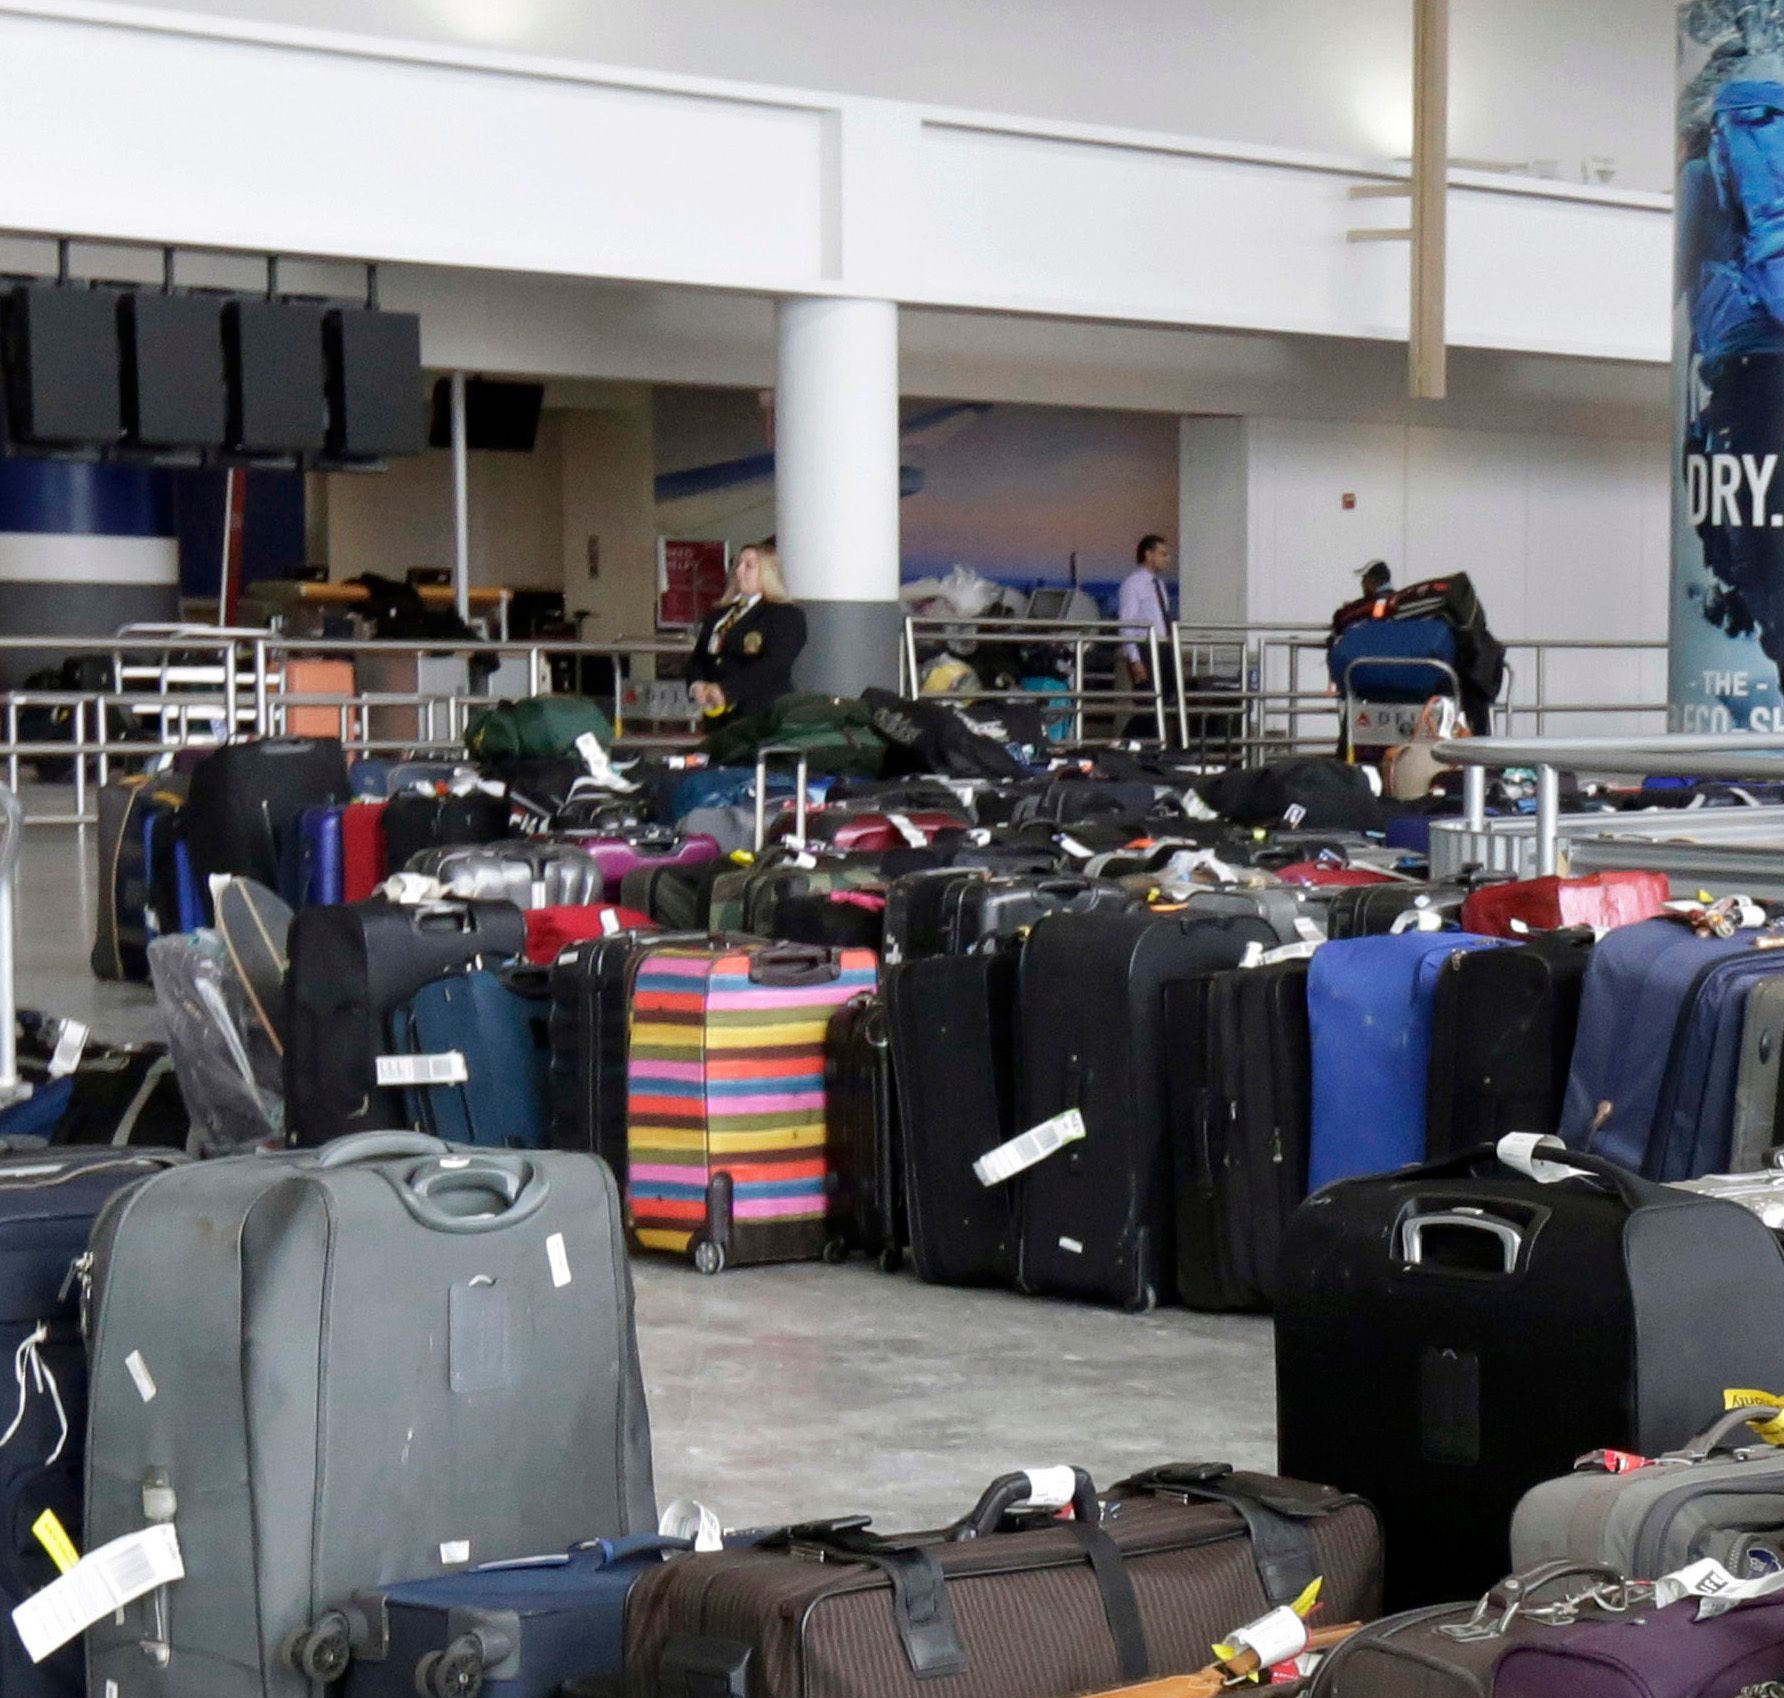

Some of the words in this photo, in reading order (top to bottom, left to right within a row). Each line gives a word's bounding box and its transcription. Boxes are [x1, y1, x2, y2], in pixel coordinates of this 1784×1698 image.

[1686, 454, 1784, 528] DRY.
[1704, 671, 1749, 697] THE
[1696, 1571, 1728, 1595] JFK
